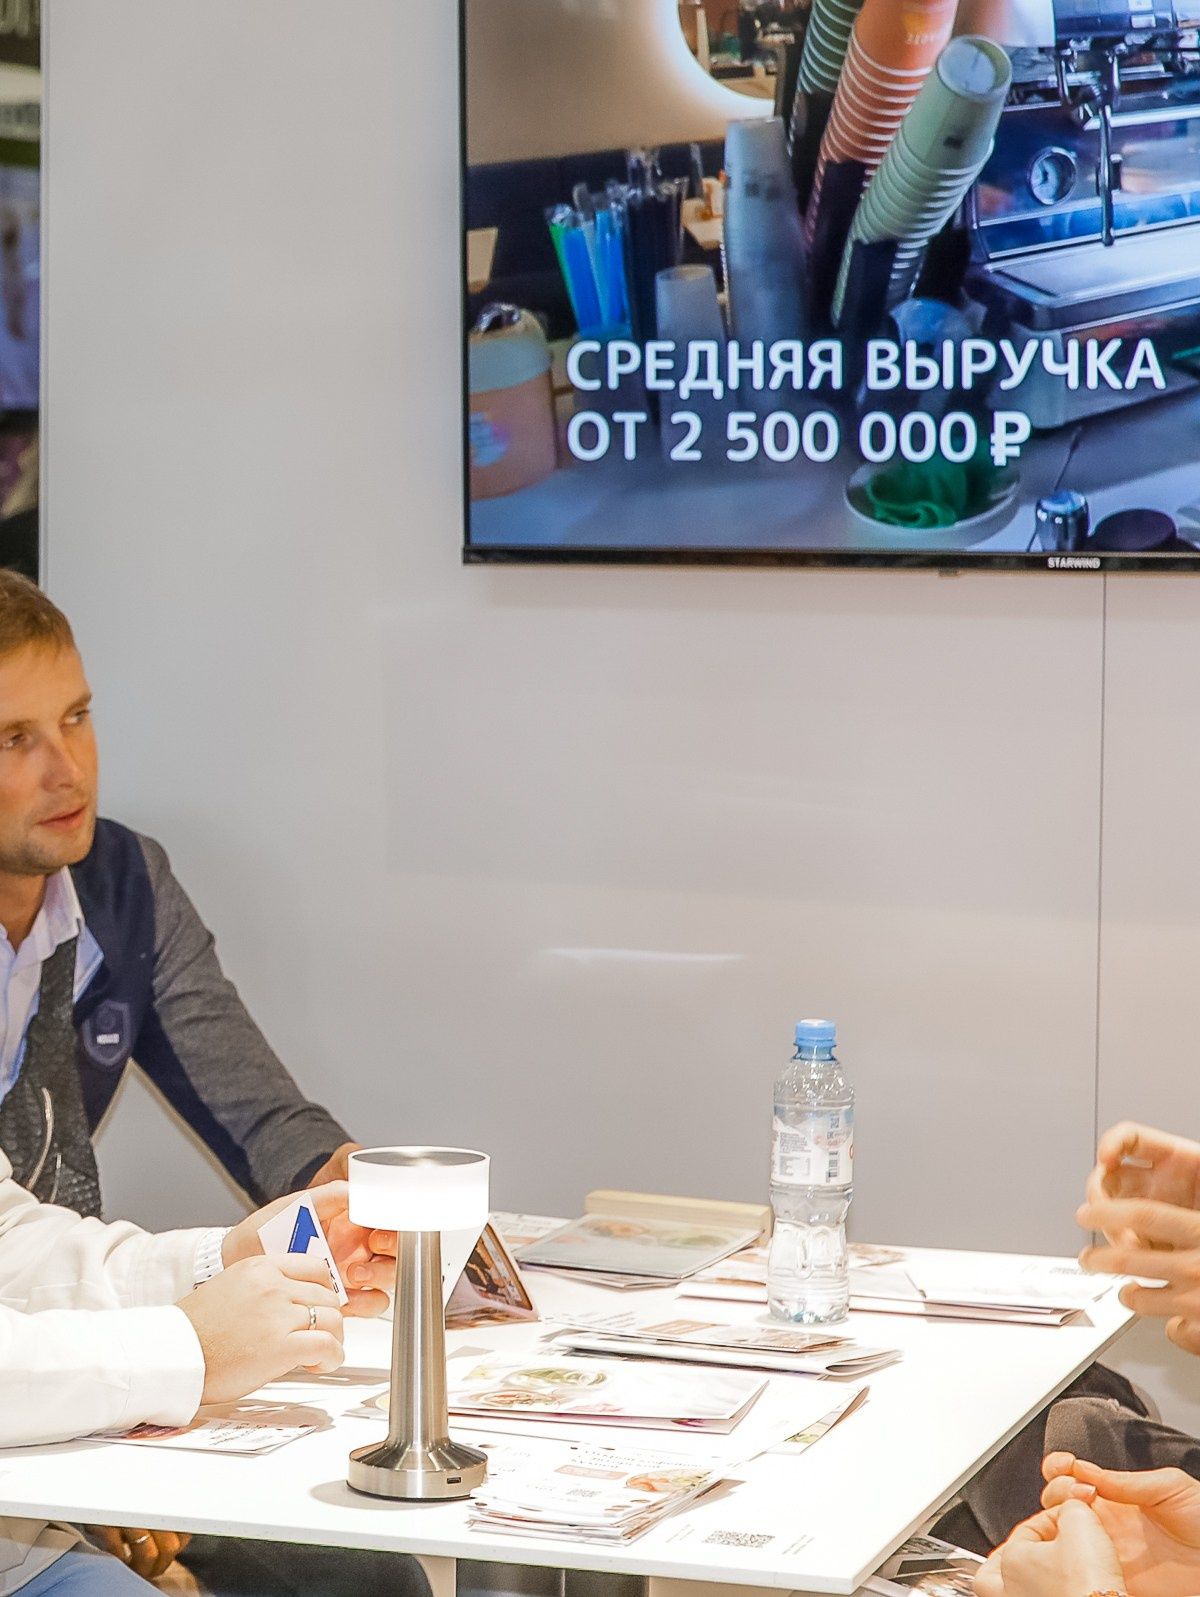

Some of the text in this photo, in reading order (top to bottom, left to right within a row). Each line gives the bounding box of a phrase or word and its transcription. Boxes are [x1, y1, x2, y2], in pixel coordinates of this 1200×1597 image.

[566, 338, 1166, 400] СРЕДНЯЯ ВЫРУЧКА
[567, 411, 647, 462] ОТ
[670, 411, 702, 461] 2
[726, 411, 840, 463] 500
[859, 411, 978, 463] 000
[1047, 556, 1101, 569] STARWIND
